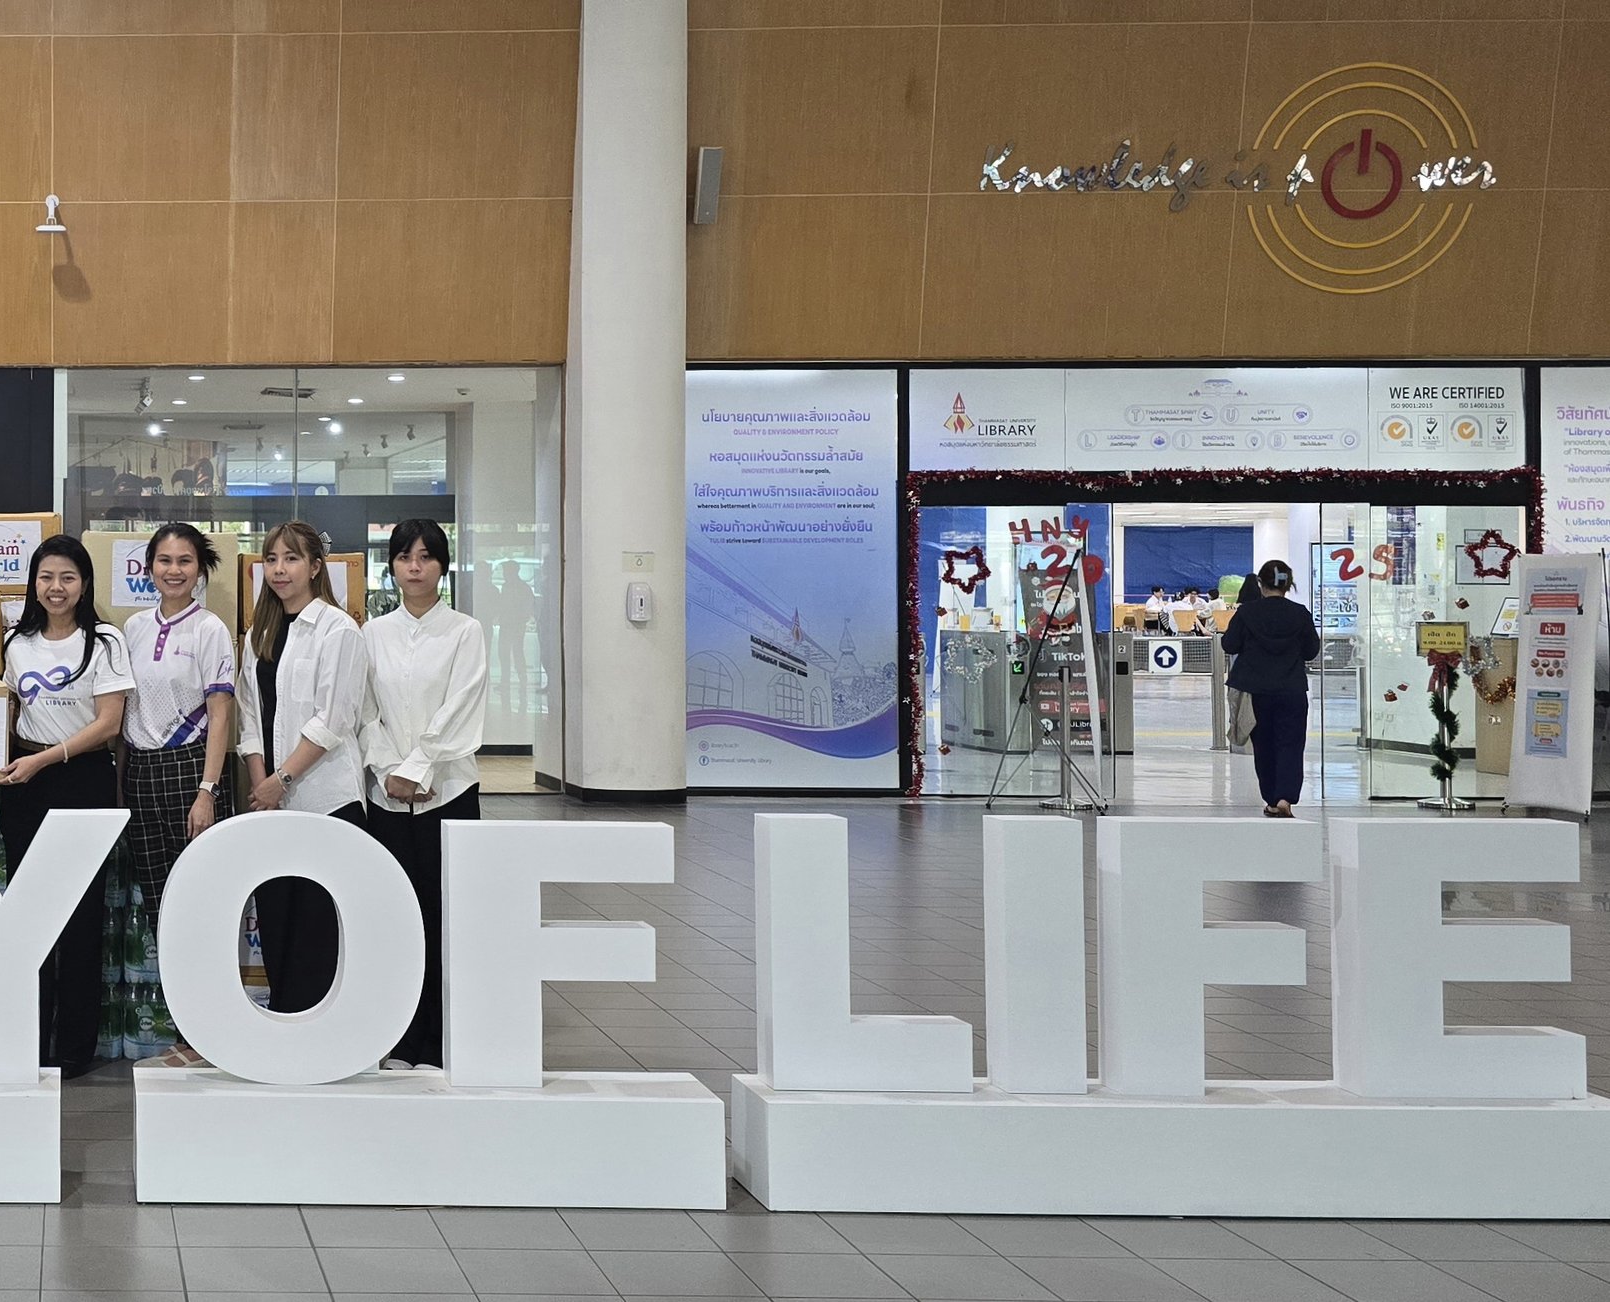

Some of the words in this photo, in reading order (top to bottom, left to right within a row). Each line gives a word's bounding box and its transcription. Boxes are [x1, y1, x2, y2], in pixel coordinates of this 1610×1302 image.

[1225, 150, 1270, 192] is
[1389, 387, 1410, 399] WE
[1413, 387, 1438, 399] ARE
[1441, 387, 1505, 399] CERTIFIED
[702, 407, 871, 425] นโยบายคุณภาพและสิ่งแวดล้อม
[978, 424, 1036, 436] LIBRARY
[710, 446, 864, 465] หอสมุดแห่งนวัตกรรมล้ำสมัย
[694, 482, 879, 500] ใส่ใจคุณภาพบริการและสิ่งแวดล้อม
[1557, 497, 1605, 511] พันธกิจ
[700, 517, 873, 533] พร้อมก้าวหน้าพัฒนาอย่างยั่งยืน
[158, 809, 675, 1088] OF
[754, 813, 1587, 1100] LIFE
